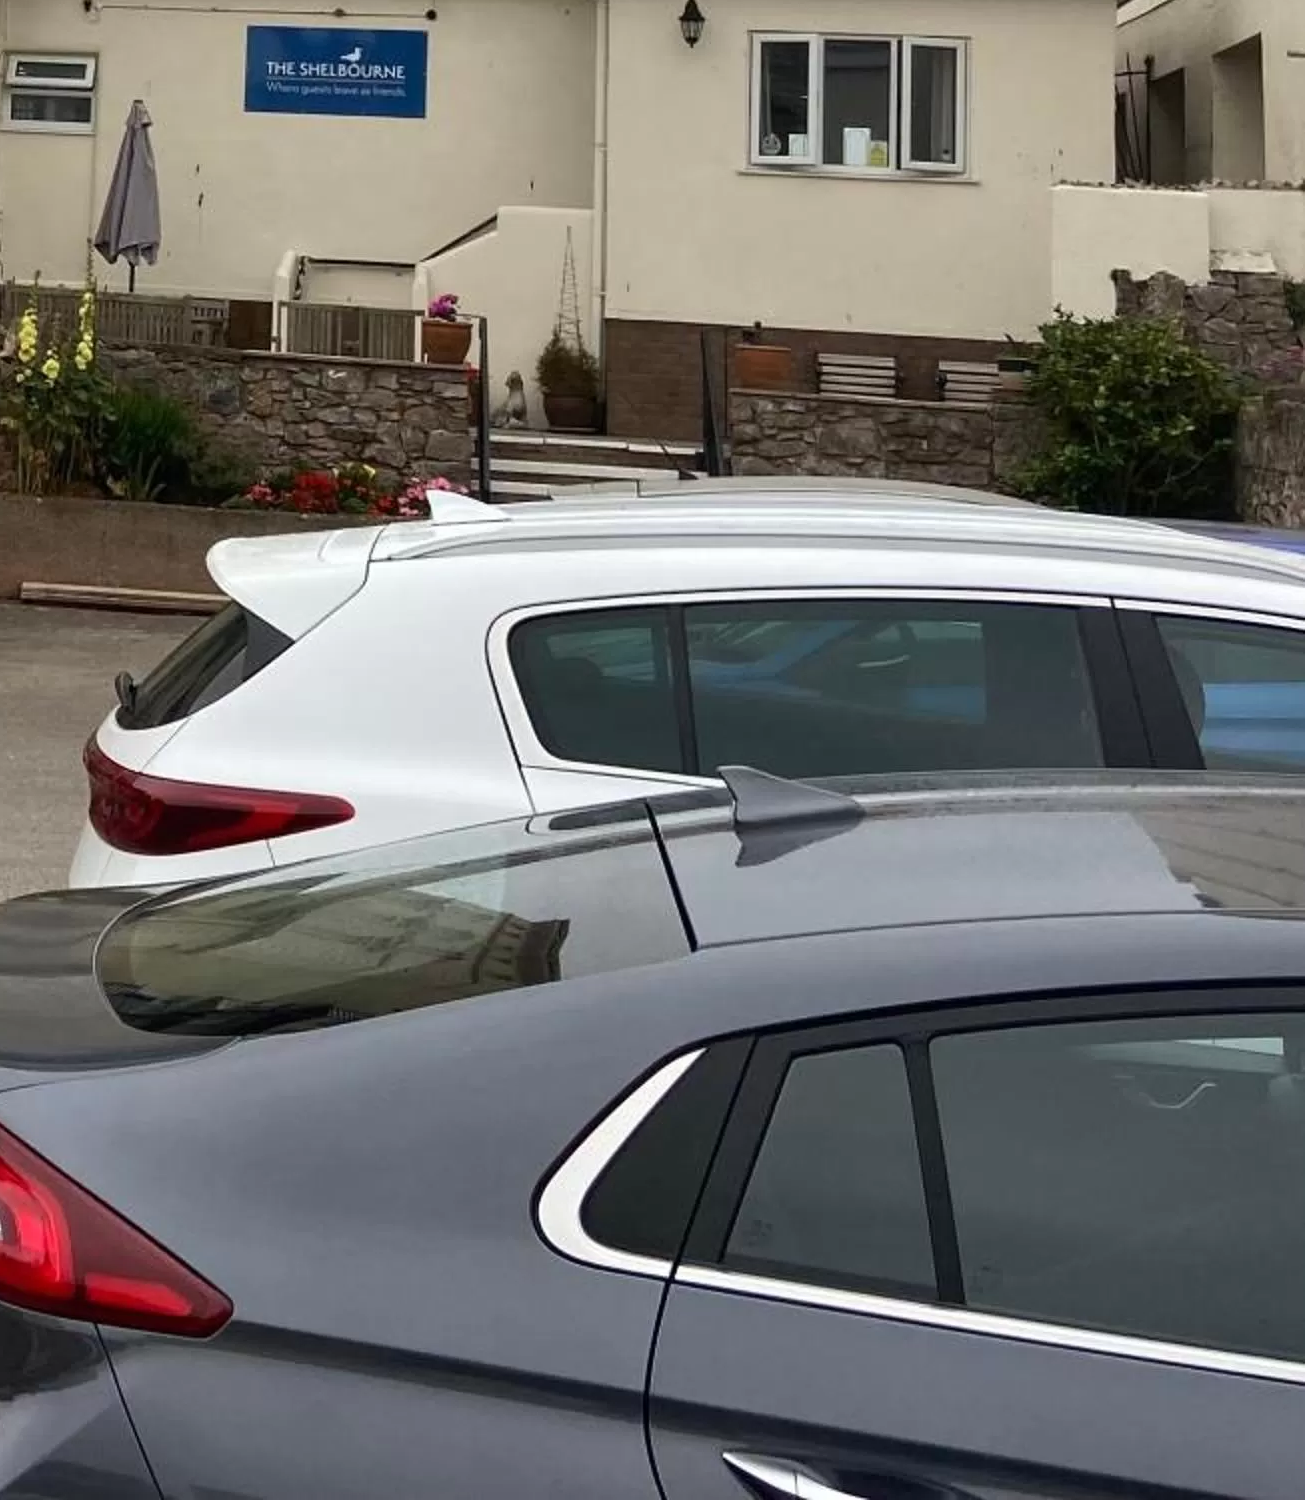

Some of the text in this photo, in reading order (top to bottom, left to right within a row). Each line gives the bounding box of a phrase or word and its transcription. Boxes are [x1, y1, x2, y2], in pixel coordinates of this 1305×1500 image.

[266, 61, 406, 79] THE SHELBOURNE
[266, 81, 299, 93] Where
[301, 84, 331, 96] guests
